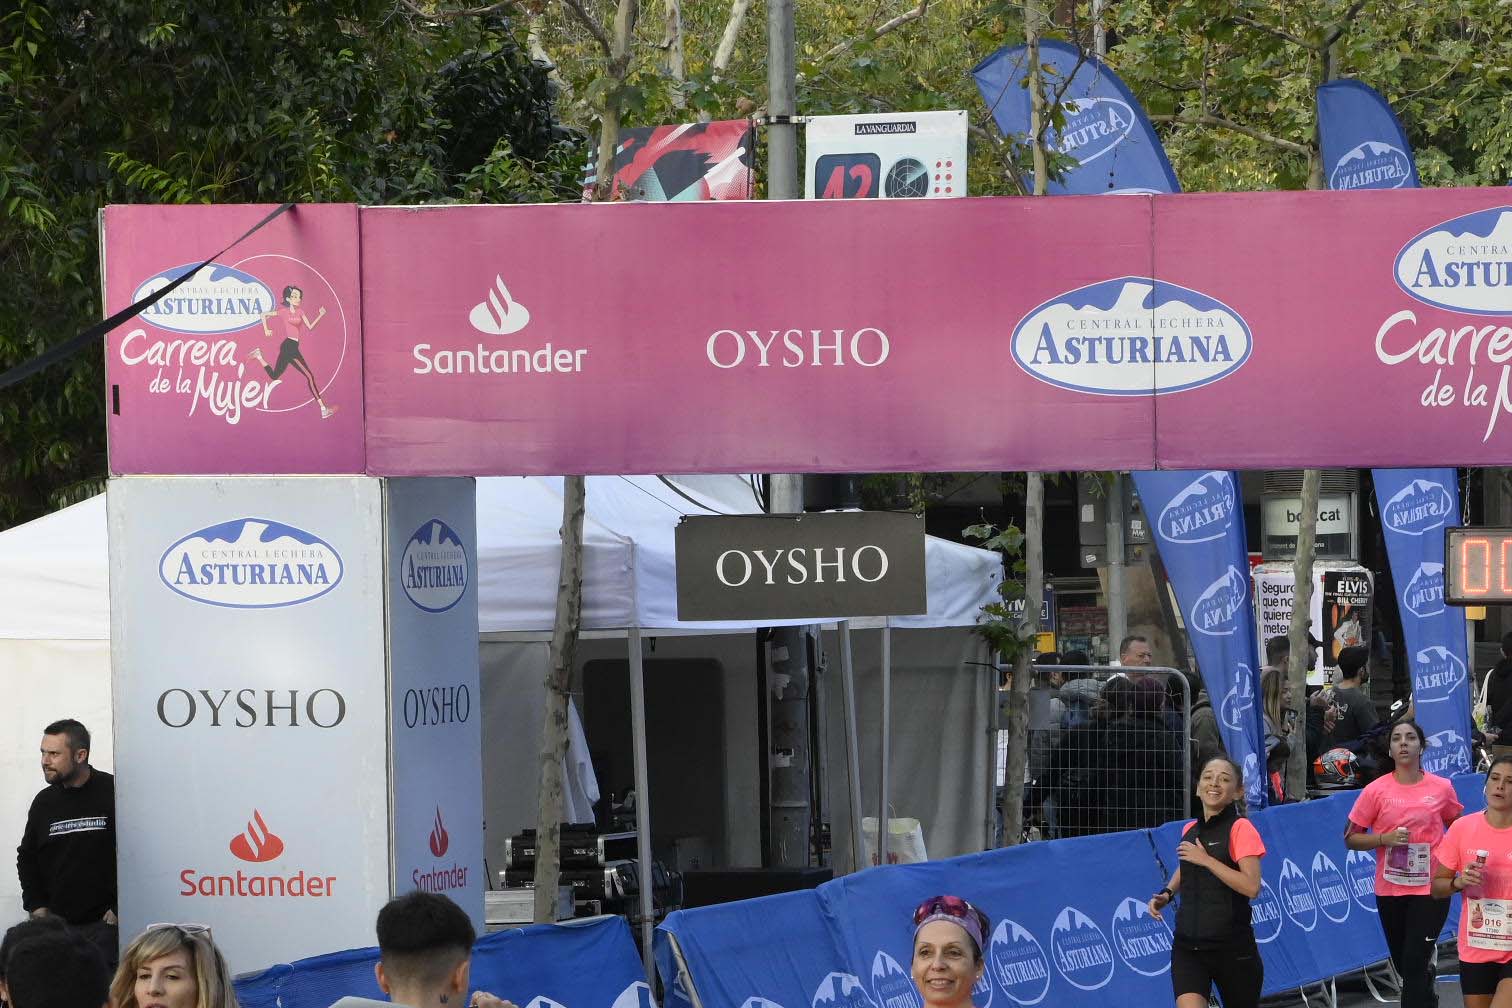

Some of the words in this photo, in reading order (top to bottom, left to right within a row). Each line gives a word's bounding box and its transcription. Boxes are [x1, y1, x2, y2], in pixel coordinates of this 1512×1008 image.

[866, 123, 915, 134] VANGUARDIA
[171, 286, 209, 296] ENTRAL
[210, 286, 260, 296] LECHERA
[1067, 319, 1142, 331] CENTRAL
[1150, 317, 1226, 330] LECHERA
[119, 328, 238, 367] Carrera
[413, 342, 588, 375] Santander
[706, 326, 890, 369] OYSHO
[1029, 321, 1234, 366] ASTURIANA
[149, 368, 172, 394] de
[176, 365, 192, 394] la
[188, 362, 282, 425] Mujer
[1420, 368, 1456, 408] de
[1463, 366, 1488, 408] la
[174, 552, 331, 585] ASTURIANA
[202, 550, 258, 558] CENTRAL
[265, 549, 324, 558] LECHERA
[716, 545, 889, 587] OYSHO
[406, 554, 465, 589] ASTURIANA
[1337, 581, 1368, 593] ELVIS
[1263, 598, 1279, 612] que
[1337, 596, 1349, 604] BILL
[156, 688, 347, 728] OYSHO
[404, 684, 471, 729] OYSHO
[180, 869, 337, 897] Santander
[412, 863, 468, 893] Santander
[1484, 918, 1502, 927] 016
[998, 954, 1047, 986] ASTURIANA
[1056, 941, 1112, 973] ASTURIANA
